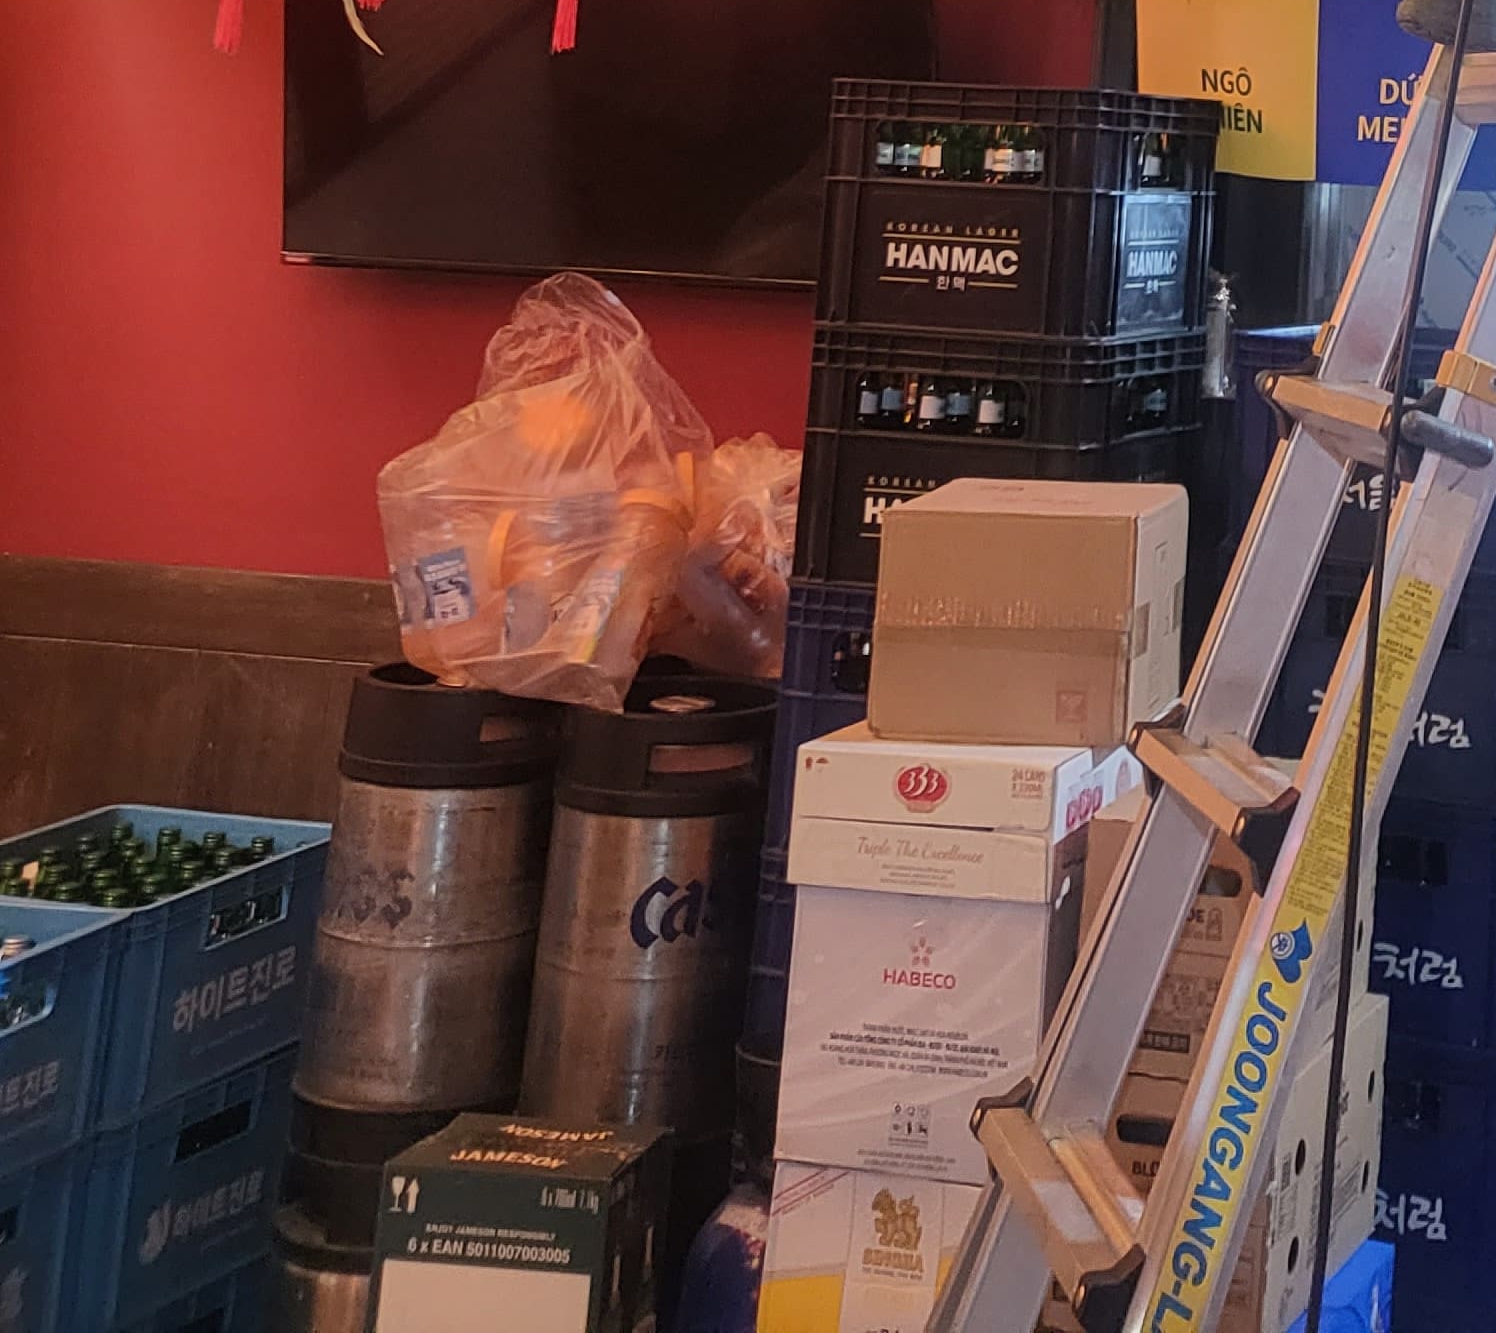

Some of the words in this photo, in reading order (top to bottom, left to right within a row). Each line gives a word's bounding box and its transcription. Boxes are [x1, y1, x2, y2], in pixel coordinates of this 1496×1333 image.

[1202, 67, 1252, 96] NGÔ
[886, 242, 1019, 276] HANMAC
[904, 763, 939, 797] 333
[173, 944, 297, 1031] 하이트진로
[883, 968, 957, 990] HABECO
[450, 1149, 568, 1171] JAMESON
[1150, 981, 1288, 1333] JOONGANG-L
[407, 1237, 417, 1253] 6
[420, 1241, 428, 1253] x
[431, 1238, 463, 1257] EAN
[466, 1241, 570, 1264] 5011007003005
